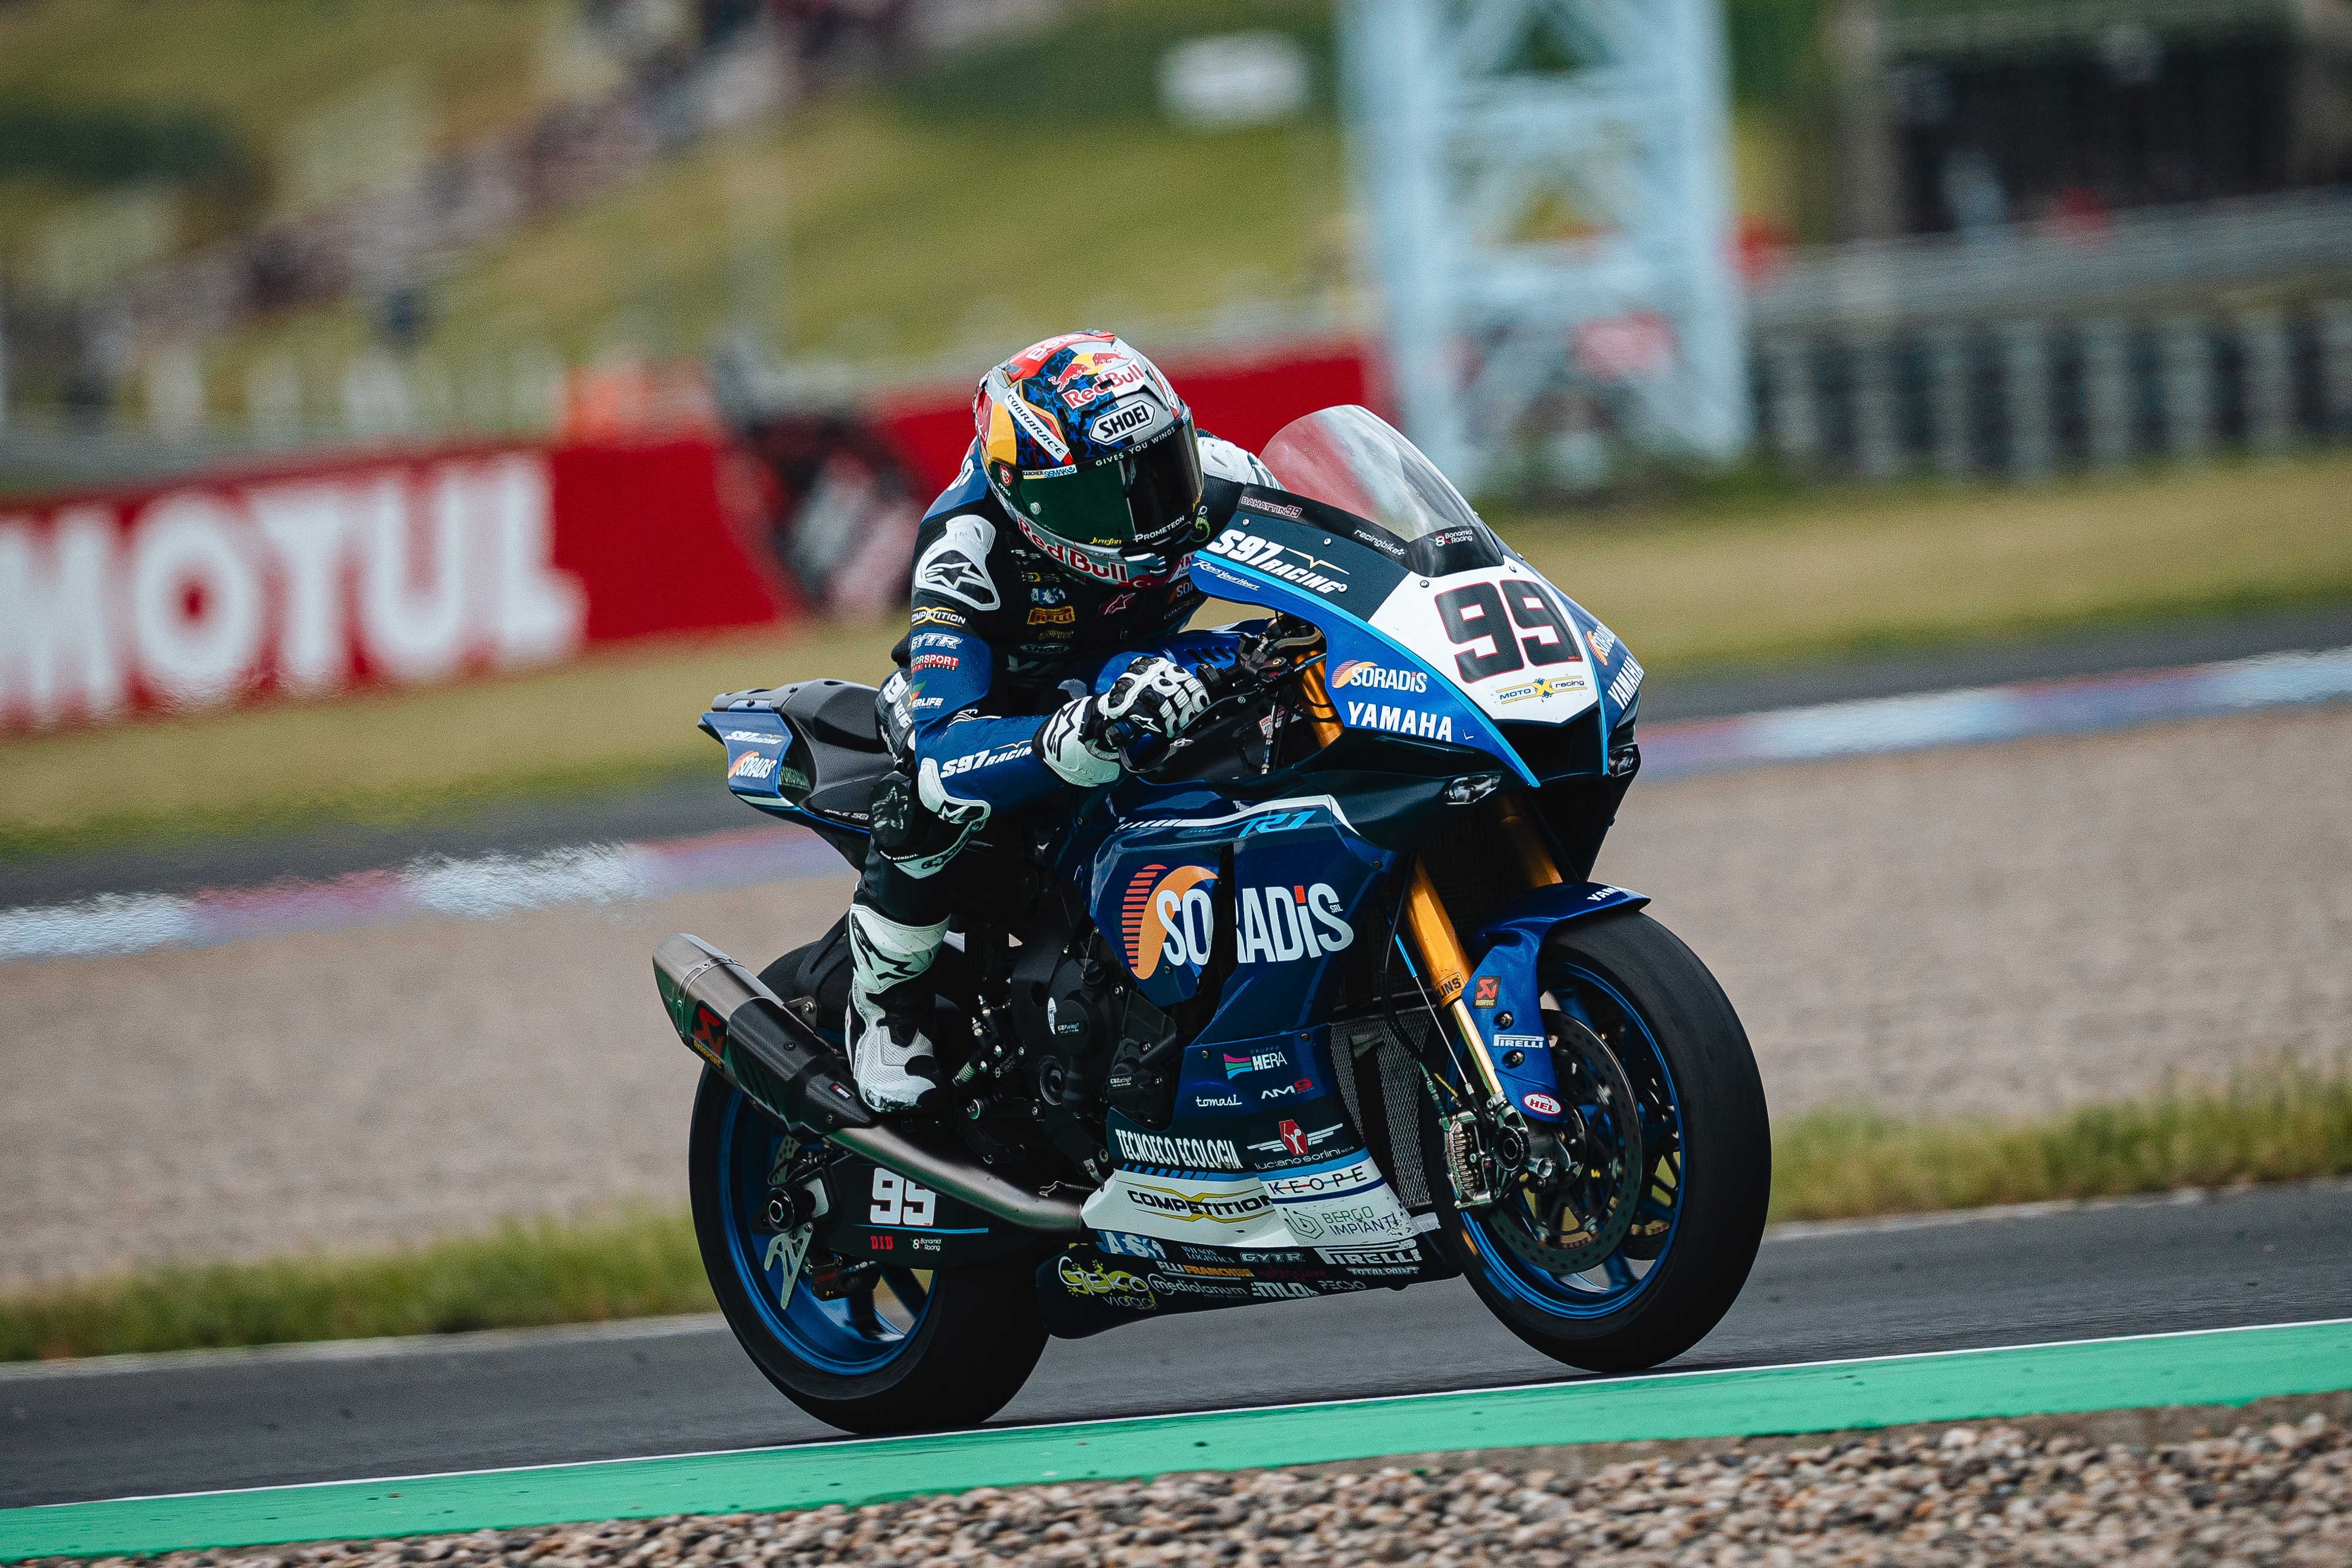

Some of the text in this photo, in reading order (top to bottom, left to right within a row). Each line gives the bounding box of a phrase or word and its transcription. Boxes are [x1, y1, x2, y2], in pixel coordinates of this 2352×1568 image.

[1064, 375, 1110, 408] Red
[1107, 364, 1144, 388] Bull
[1007, 394, 1065, 455] COBRARACE
[1098, 404, 1150, 439] SHOEI
[1095, 426, 1175, 466] GIVES YOU WINGS
[1134, 515, 1185, 542] PROMETEON
[1451, 534, 1473, 544] Racing
[1018, 516, 1067, 564] Red
[1068, 547, 1128, 583] Bull
[0, 453, 588, 729] MOTUL
[1435, 580, 1583, 683] 99
[1500, 688, 1531, 700] MOTO
[1555, 679, 1585, 688] racing
[1607, 655, 1645, 711] YAMAHA
[912, 697, 943, 708] ERLIFE
[1348, 701, 1452, 742] YAMAHA
[1587, 887, 1619, 901] YAM
[1330, 905, 1343, 913] SRL
[1436, 977, 1462, 998] LINS
[1250, 1045, 1280, 1054] GRUPPO
[1493, 1034, 1545, 1048] PIRELLI
[1252, 1051, 1288, 1071] HERA
[1196, 1095, 1242, 1106] tomasi
[1529, 1098, 1555, 1112] HEL
[1115, 1129, 1244, 1169] TECNOECO ECOLOGIA
[1255, 1158, 1302, 1170] luciano
[1302, 1148, 1341, 1162] sorlini
[870, 1168, 936, 1226] 99
[1321, 1205, 1374, 1224] BERGO
[1329, 1211, 1399, 1236] IMPIANTI
[1240, 1252, 1306, 1262] GYTR
[1314, 1238, 1422, 1264] PIRELLI
